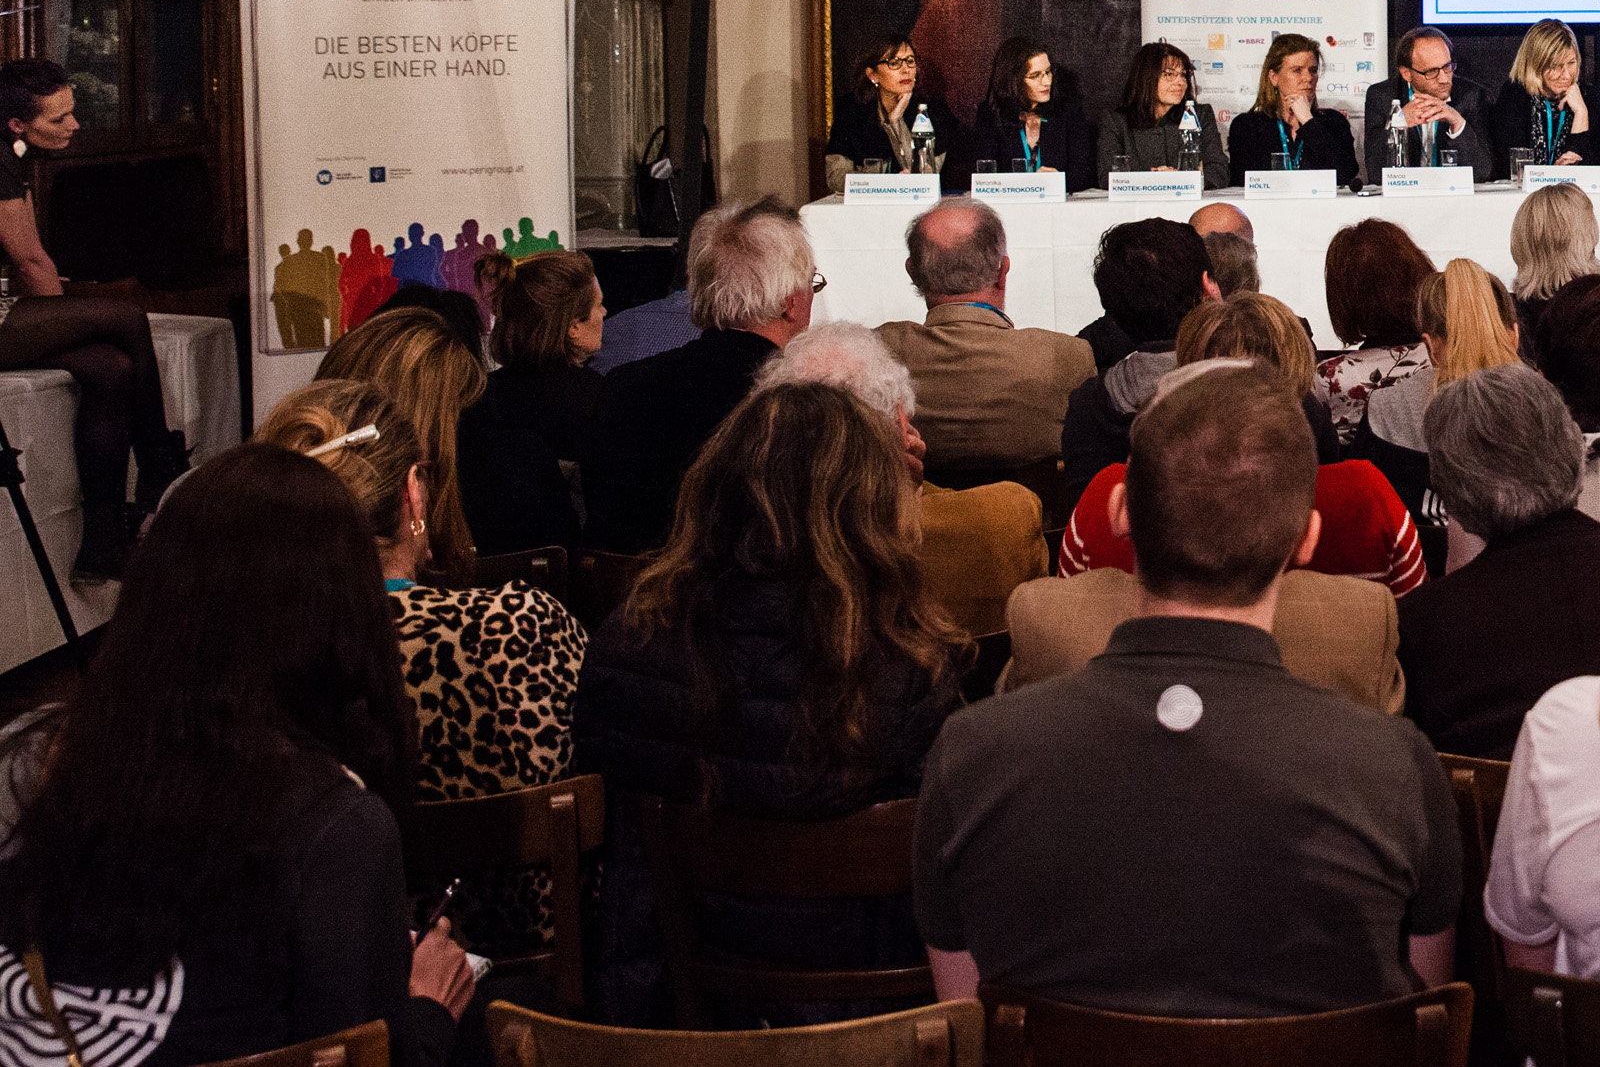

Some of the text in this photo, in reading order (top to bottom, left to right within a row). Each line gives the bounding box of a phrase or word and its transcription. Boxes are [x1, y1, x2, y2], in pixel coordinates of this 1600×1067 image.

[1157, 15, 1323, 24] UNTERSTÜTZER VON PRAEVENIRE
[315, 31, 519, 55] DIE BESTEN KÖPFE
[322, 58, 511, 80] AUS EINER HAND.
[441, 164, 525, 177] www.perigroup.at
[975, 186, 1045, 194] MACEK-STROKOSCH
